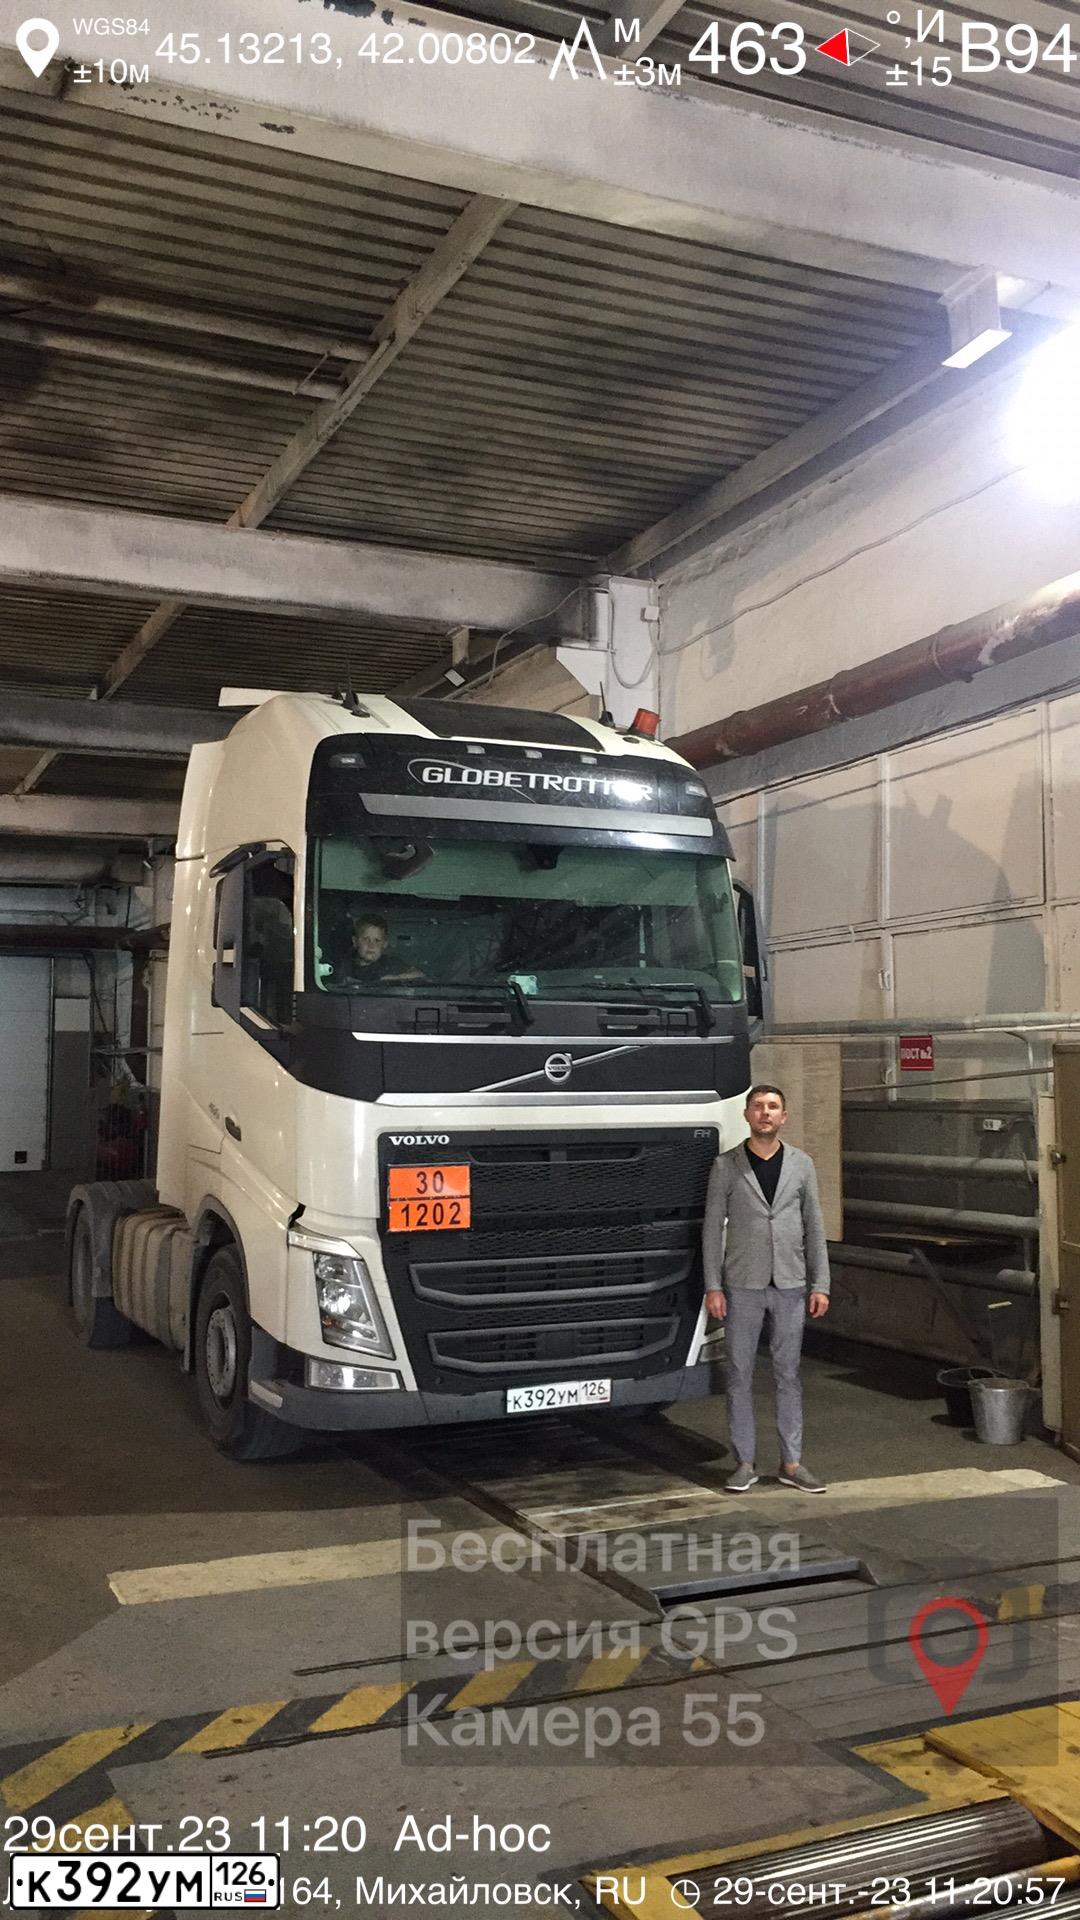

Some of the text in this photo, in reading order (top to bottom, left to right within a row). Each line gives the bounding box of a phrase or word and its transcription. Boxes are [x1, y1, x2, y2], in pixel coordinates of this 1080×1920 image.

[422, 767, 653, 801] GLOBETROTTR
[388, 1134, 450, 1146] VOLVO
[694, 1129, 711, 1138] FH
[416, 1170, 445, 1195] 30
[400, 1202, 462, 1228] 1202
[582, 1381, 606, 1396] 126
